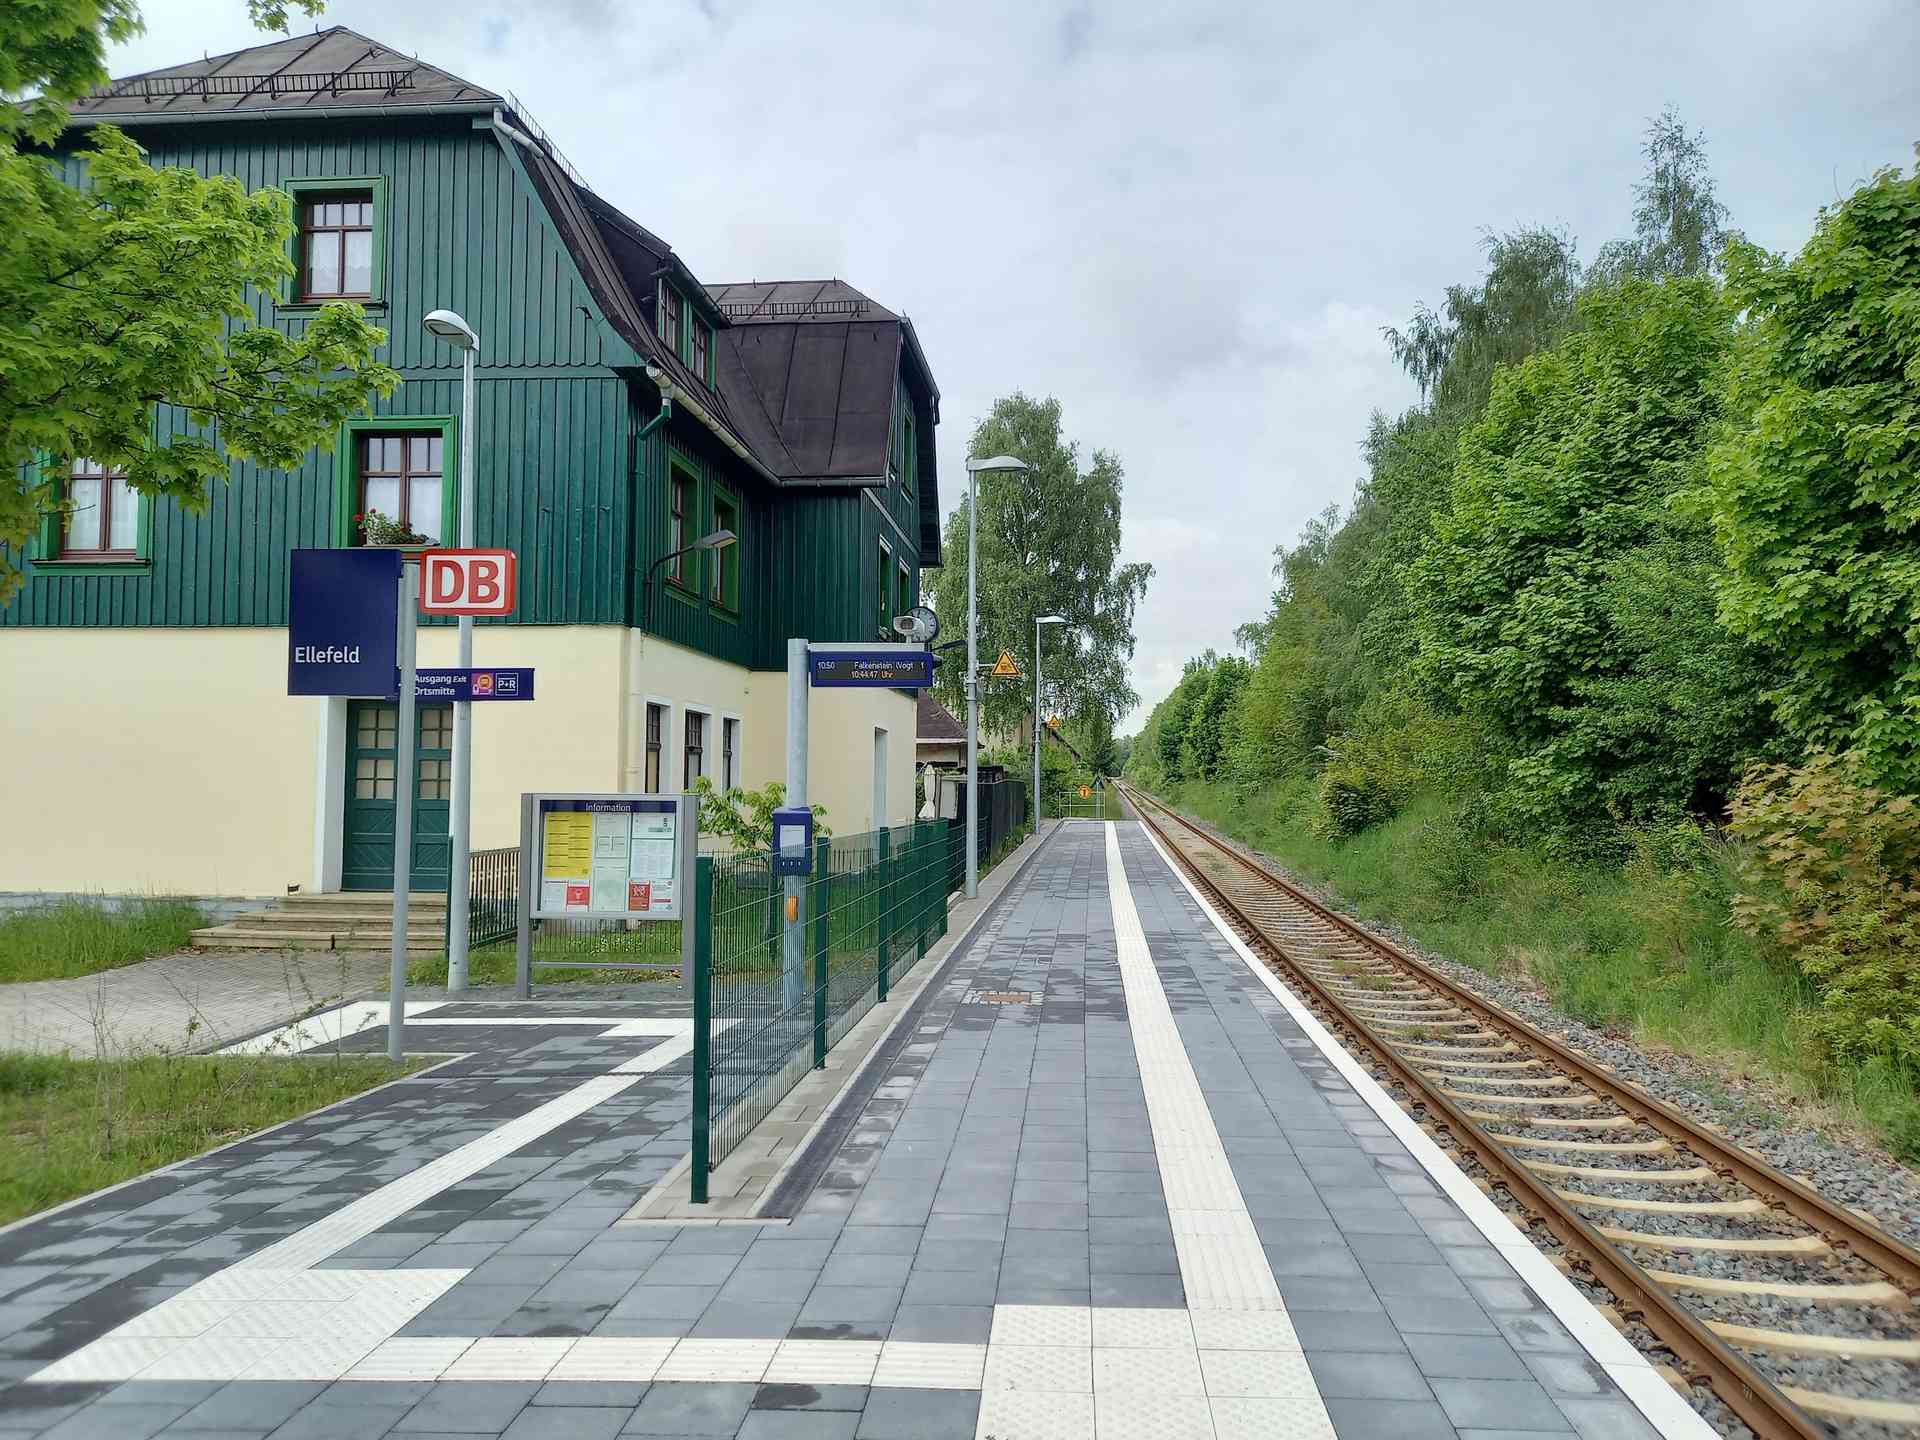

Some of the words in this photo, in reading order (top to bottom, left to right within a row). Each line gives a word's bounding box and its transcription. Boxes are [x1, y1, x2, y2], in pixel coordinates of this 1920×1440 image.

[431, 560, 500, 604] DB
[295, 646, 360, 664] Ellefeld
[854, 661, 893, 670] Falkenstein
[453, 675, 467, 683] Exit
[881, 670, 894, 679] Uhr
[497, 680, 516, 689] P+R
[585, 803, 631, 812] Information
